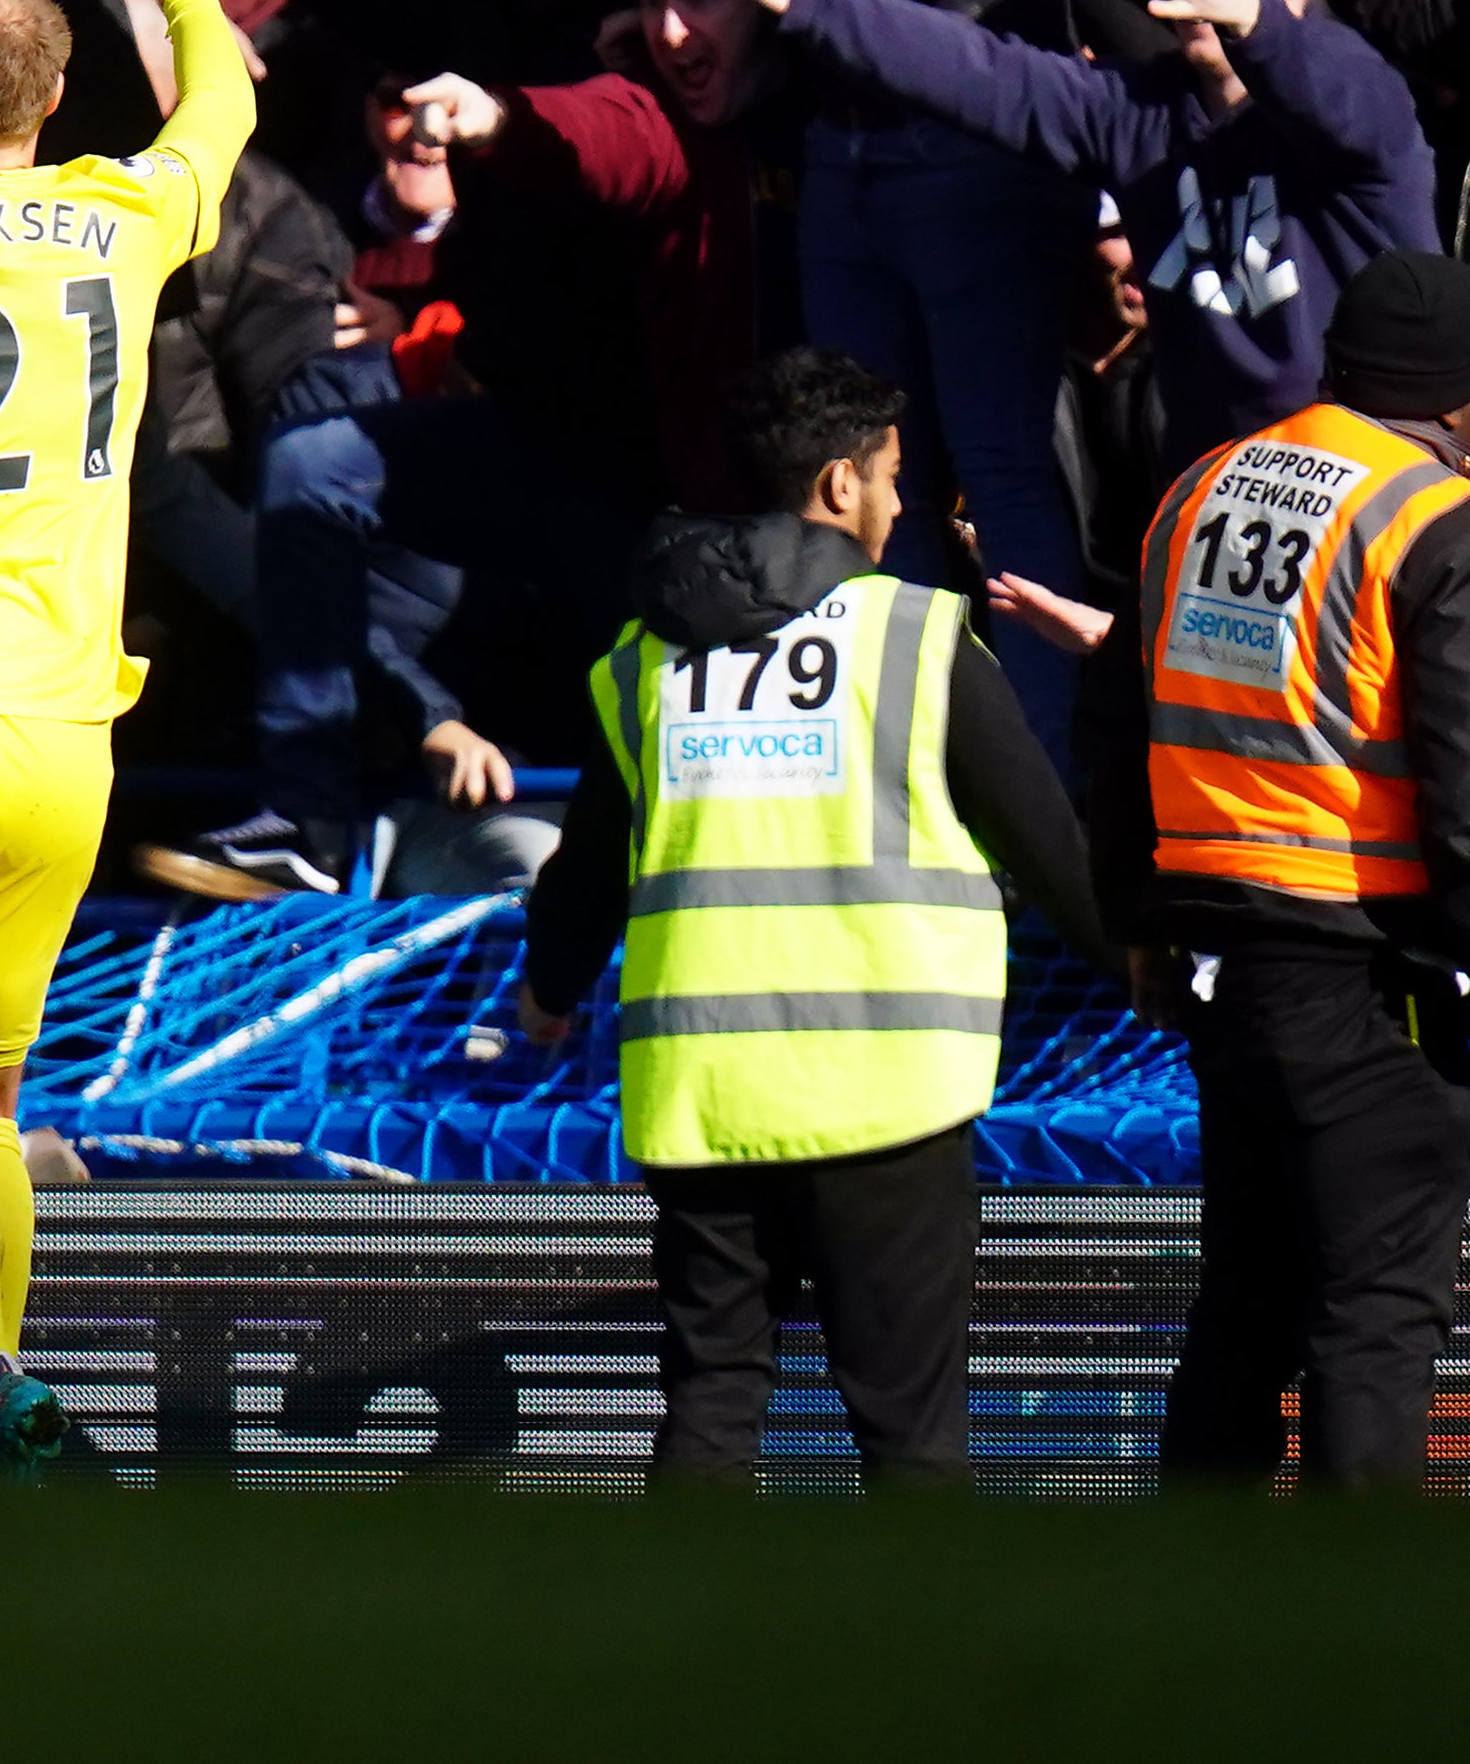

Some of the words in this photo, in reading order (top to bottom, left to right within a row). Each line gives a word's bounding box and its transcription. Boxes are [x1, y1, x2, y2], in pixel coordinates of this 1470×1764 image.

[1237, 446, 1353, 487] SUPPORT
[1215, 474, 1333, 517] STEWARD
[1194, 512, 1311, 605] 133
[1181, 608, 1275, 650] servoca
[674, 636, 838, 713] 179
[681, 734, 822, 760] servoca
